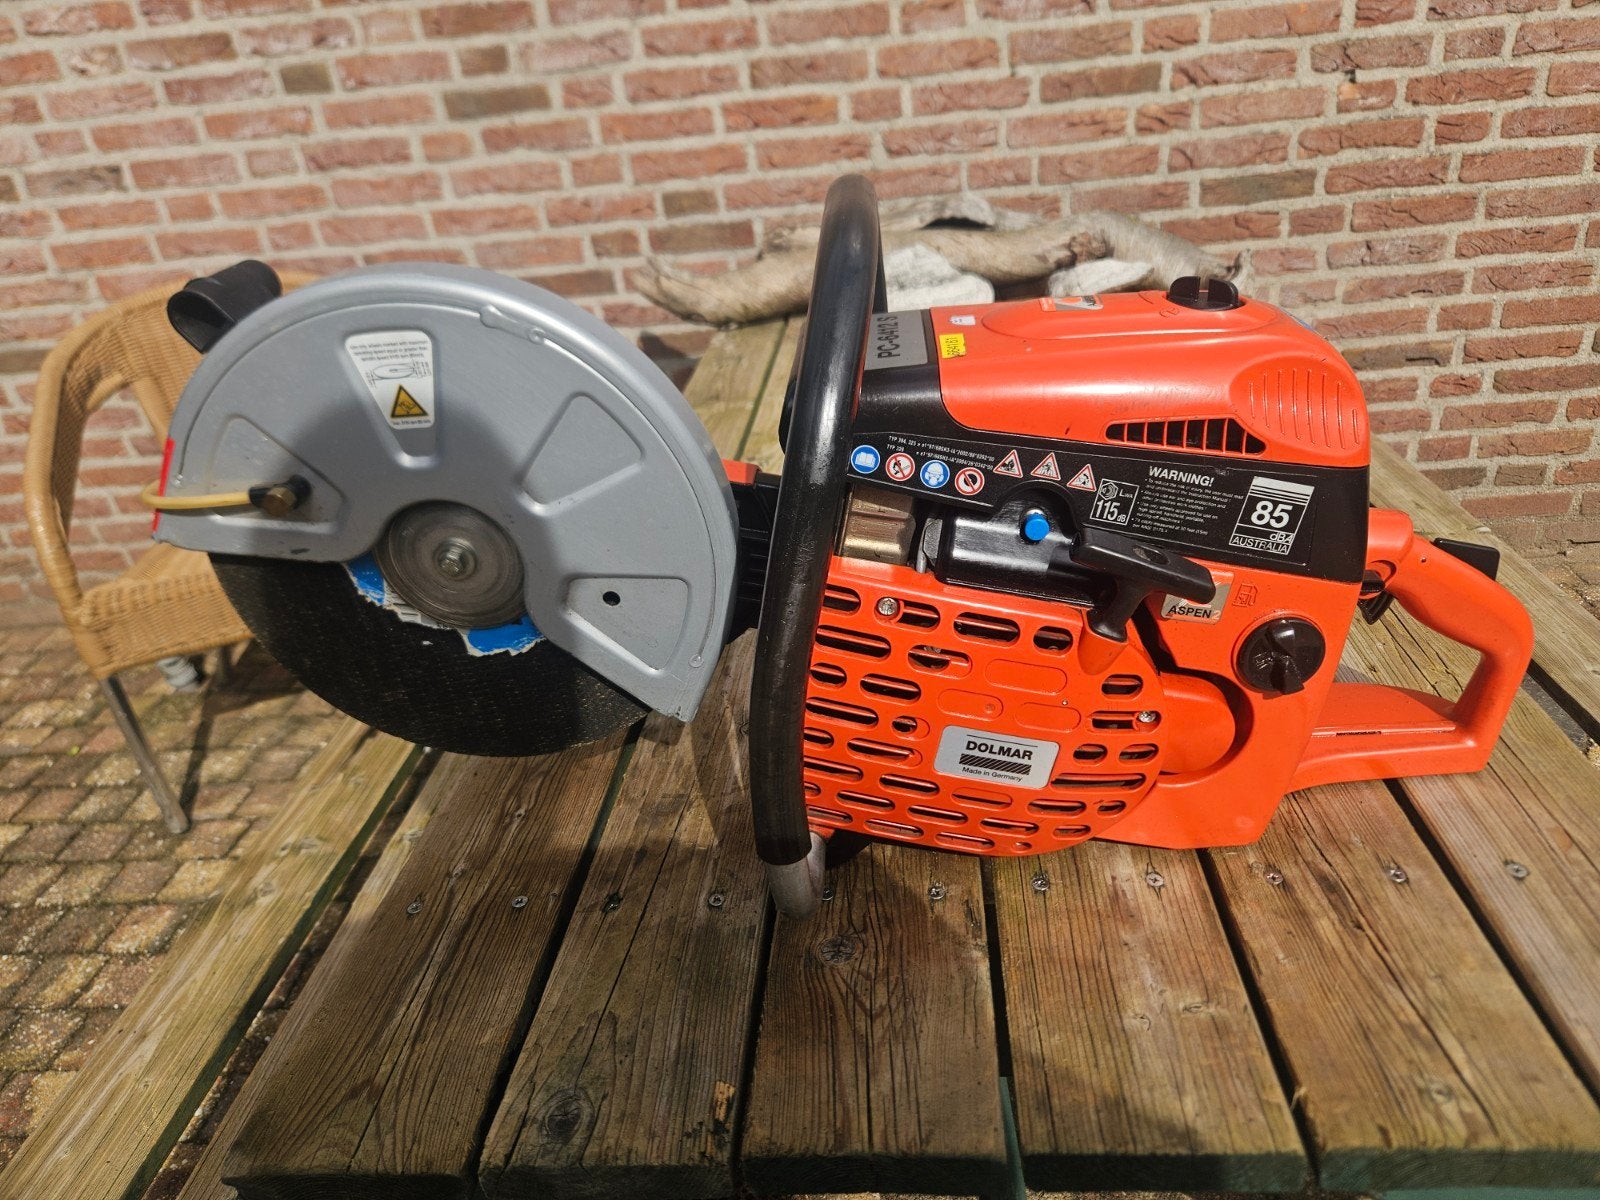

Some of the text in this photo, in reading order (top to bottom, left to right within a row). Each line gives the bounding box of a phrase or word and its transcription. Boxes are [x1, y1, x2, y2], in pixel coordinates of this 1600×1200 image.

[877, 321, 900, 359] PC-6412
[1149, 466, 1214, 487] WARNING!
[1096, 500, 1120, 520] 115
[1117, 514, 1126, 522] dB
[1251, 500, 1293, 529] 85
[1232, 536, 1288, 553] AUSTRALIA
[1270, 531, 1294, 545] dBA
[1167, 605, 1212, 618] ASPEN
[965, 740, 1033, 760] DOLMAR
[962, 766, 982, 775] Made
[991, 771, 1023, 783] Germany
